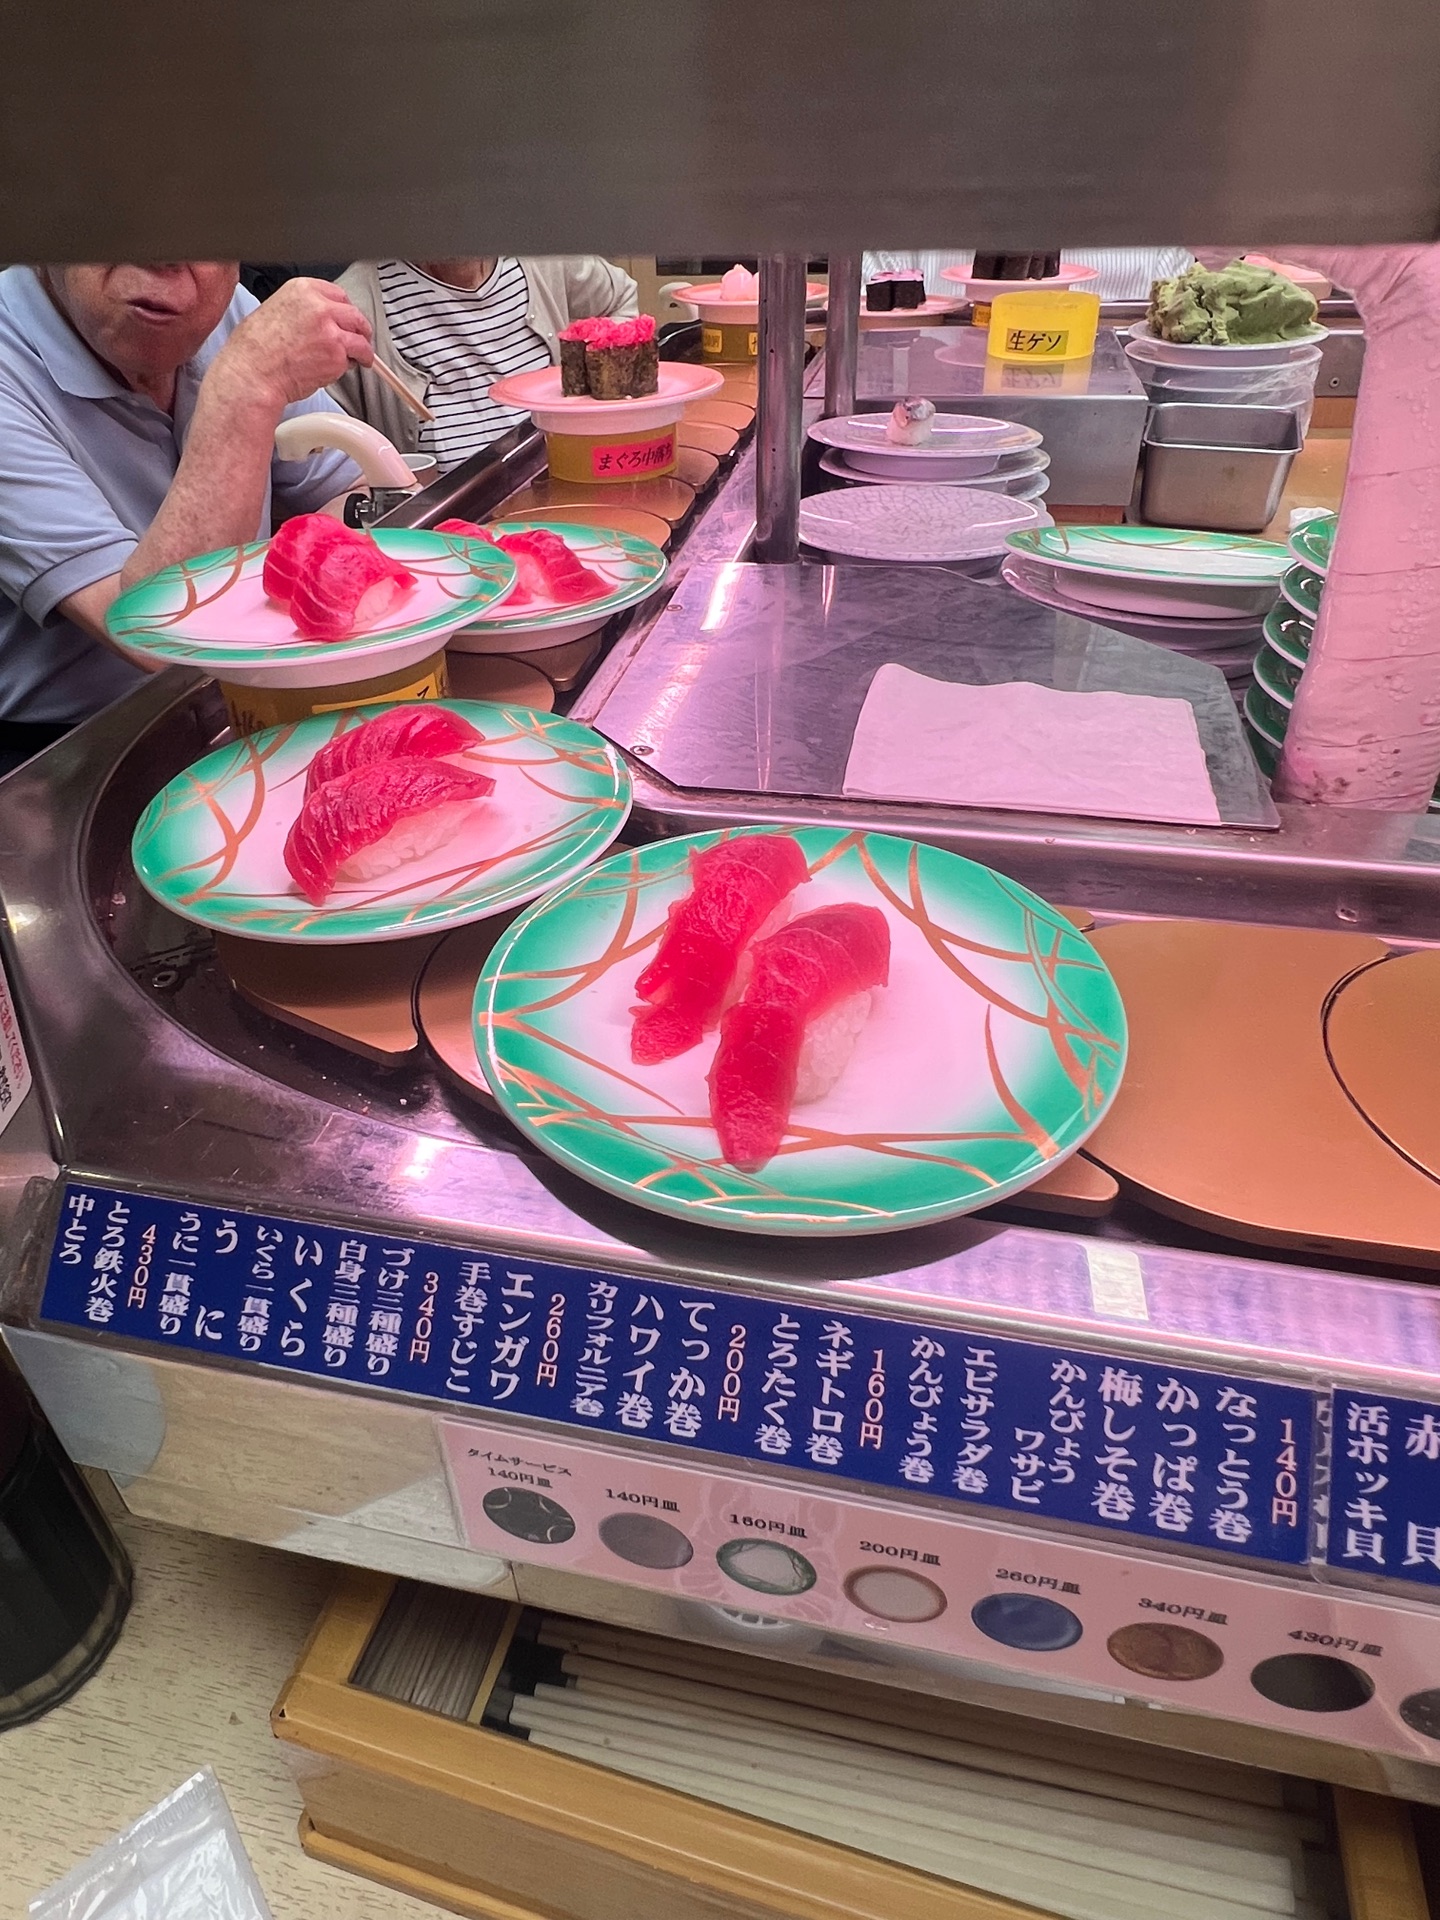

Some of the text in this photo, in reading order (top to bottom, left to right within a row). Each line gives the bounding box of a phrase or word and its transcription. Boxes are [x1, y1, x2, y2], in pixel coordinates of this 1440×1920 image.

[1007, 330, 1061, 352] 生ゲソ
[59, 1194, 95, 1265] 中とろ
[84, 1200, 131, 1323] とろ鉄火巻
[127, 1224, 157, 1309] 430円
[158, 1211, 201, 1335] うに一貫盛り
[237, 1225, 284, 1351] いくら一貫盛り
[280, 1234, 323, 1357] いくら
[322, 1240, 368, 1367] 白身三種盛り
[365, 1247, 416, 1376] づけ三種盛り
[409, 1271, 439, 1364] 340円
[446, 1261, 491, 1393] 手巻すじこ
[490, 1270, 535, 1400] エンガワ
[536, 1293, 566, 1388] 260円
[569, 1280, 619, 1417] カリフォルニア巻
[615, 1294, 664, 1429] ハワイ巻
[663, 1300, 716, 1438] てっか巻
[717, 1324, 747, 1422] 200円
[754, 1312, 800, 1455] とろたく巻
[804, 1320, 856, 1465] ネギトロ巻
[859, 1349, 886, 1450] 160円
[898, 1335, 946, 1484] かんぴょう巻
[952, 1346, 998, 1494] エビサラダ巻
[1048, 1358, 1088, 1484] かんぴょう
[468, 1448, 572, 1477] タイムサービス
[488, 1467, 553, 1488] 140円皿
[605, 1488, 681, 1512] 140円皿
[1009, 1427, 1046, 1504] ワサビ
[1090, 1366, 1143, 1521] 梅しそ巻
[1148, 1377, 1200, 1533] かっぱ巻
[1208, 1386, 1258, 1544] なっとう巻
[1271, 1418, 1298, 1527] 140円
[1342, 1401, 1390, 1565] 活ホッキ貝
[859, 1540, 941, 1566] 200円皿
[994, 1568, 1081, 1596] 260円皿
[1138, 1597, 1229, 1626] 340円皿
[1287, 1629, 1383, 1658] 430円皿
